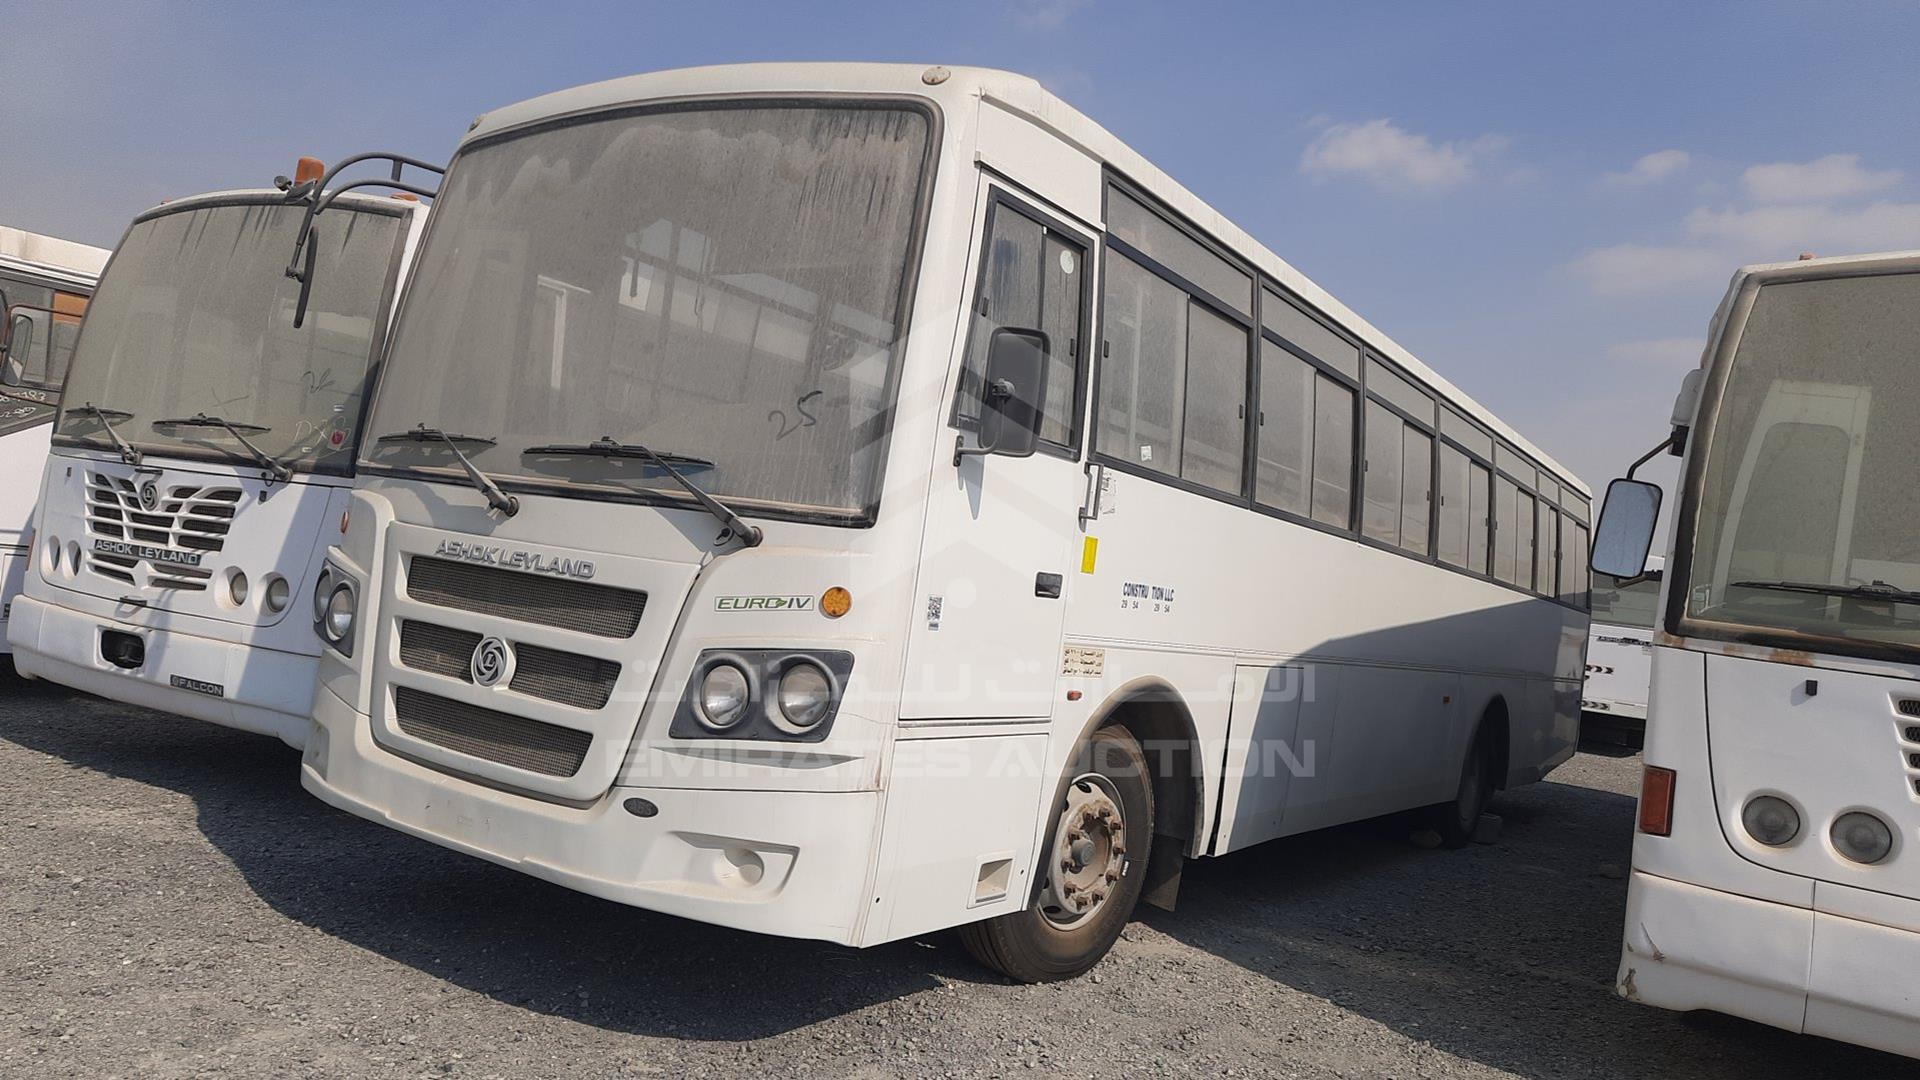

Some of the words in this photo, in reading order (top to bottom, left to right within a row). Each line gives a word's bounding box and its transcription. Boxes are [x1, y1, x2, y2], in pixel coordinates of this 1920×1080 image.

[768, 390, 823, 441] 25
[96, 540, 132, 555] ASHOK
[138, 547, 199, 564] LEYLAND
[434, 539, 500, 565] ASHOK
[499, 549, 597, 581] LEYLAND
[180, 678, 223, 695] FALCON
